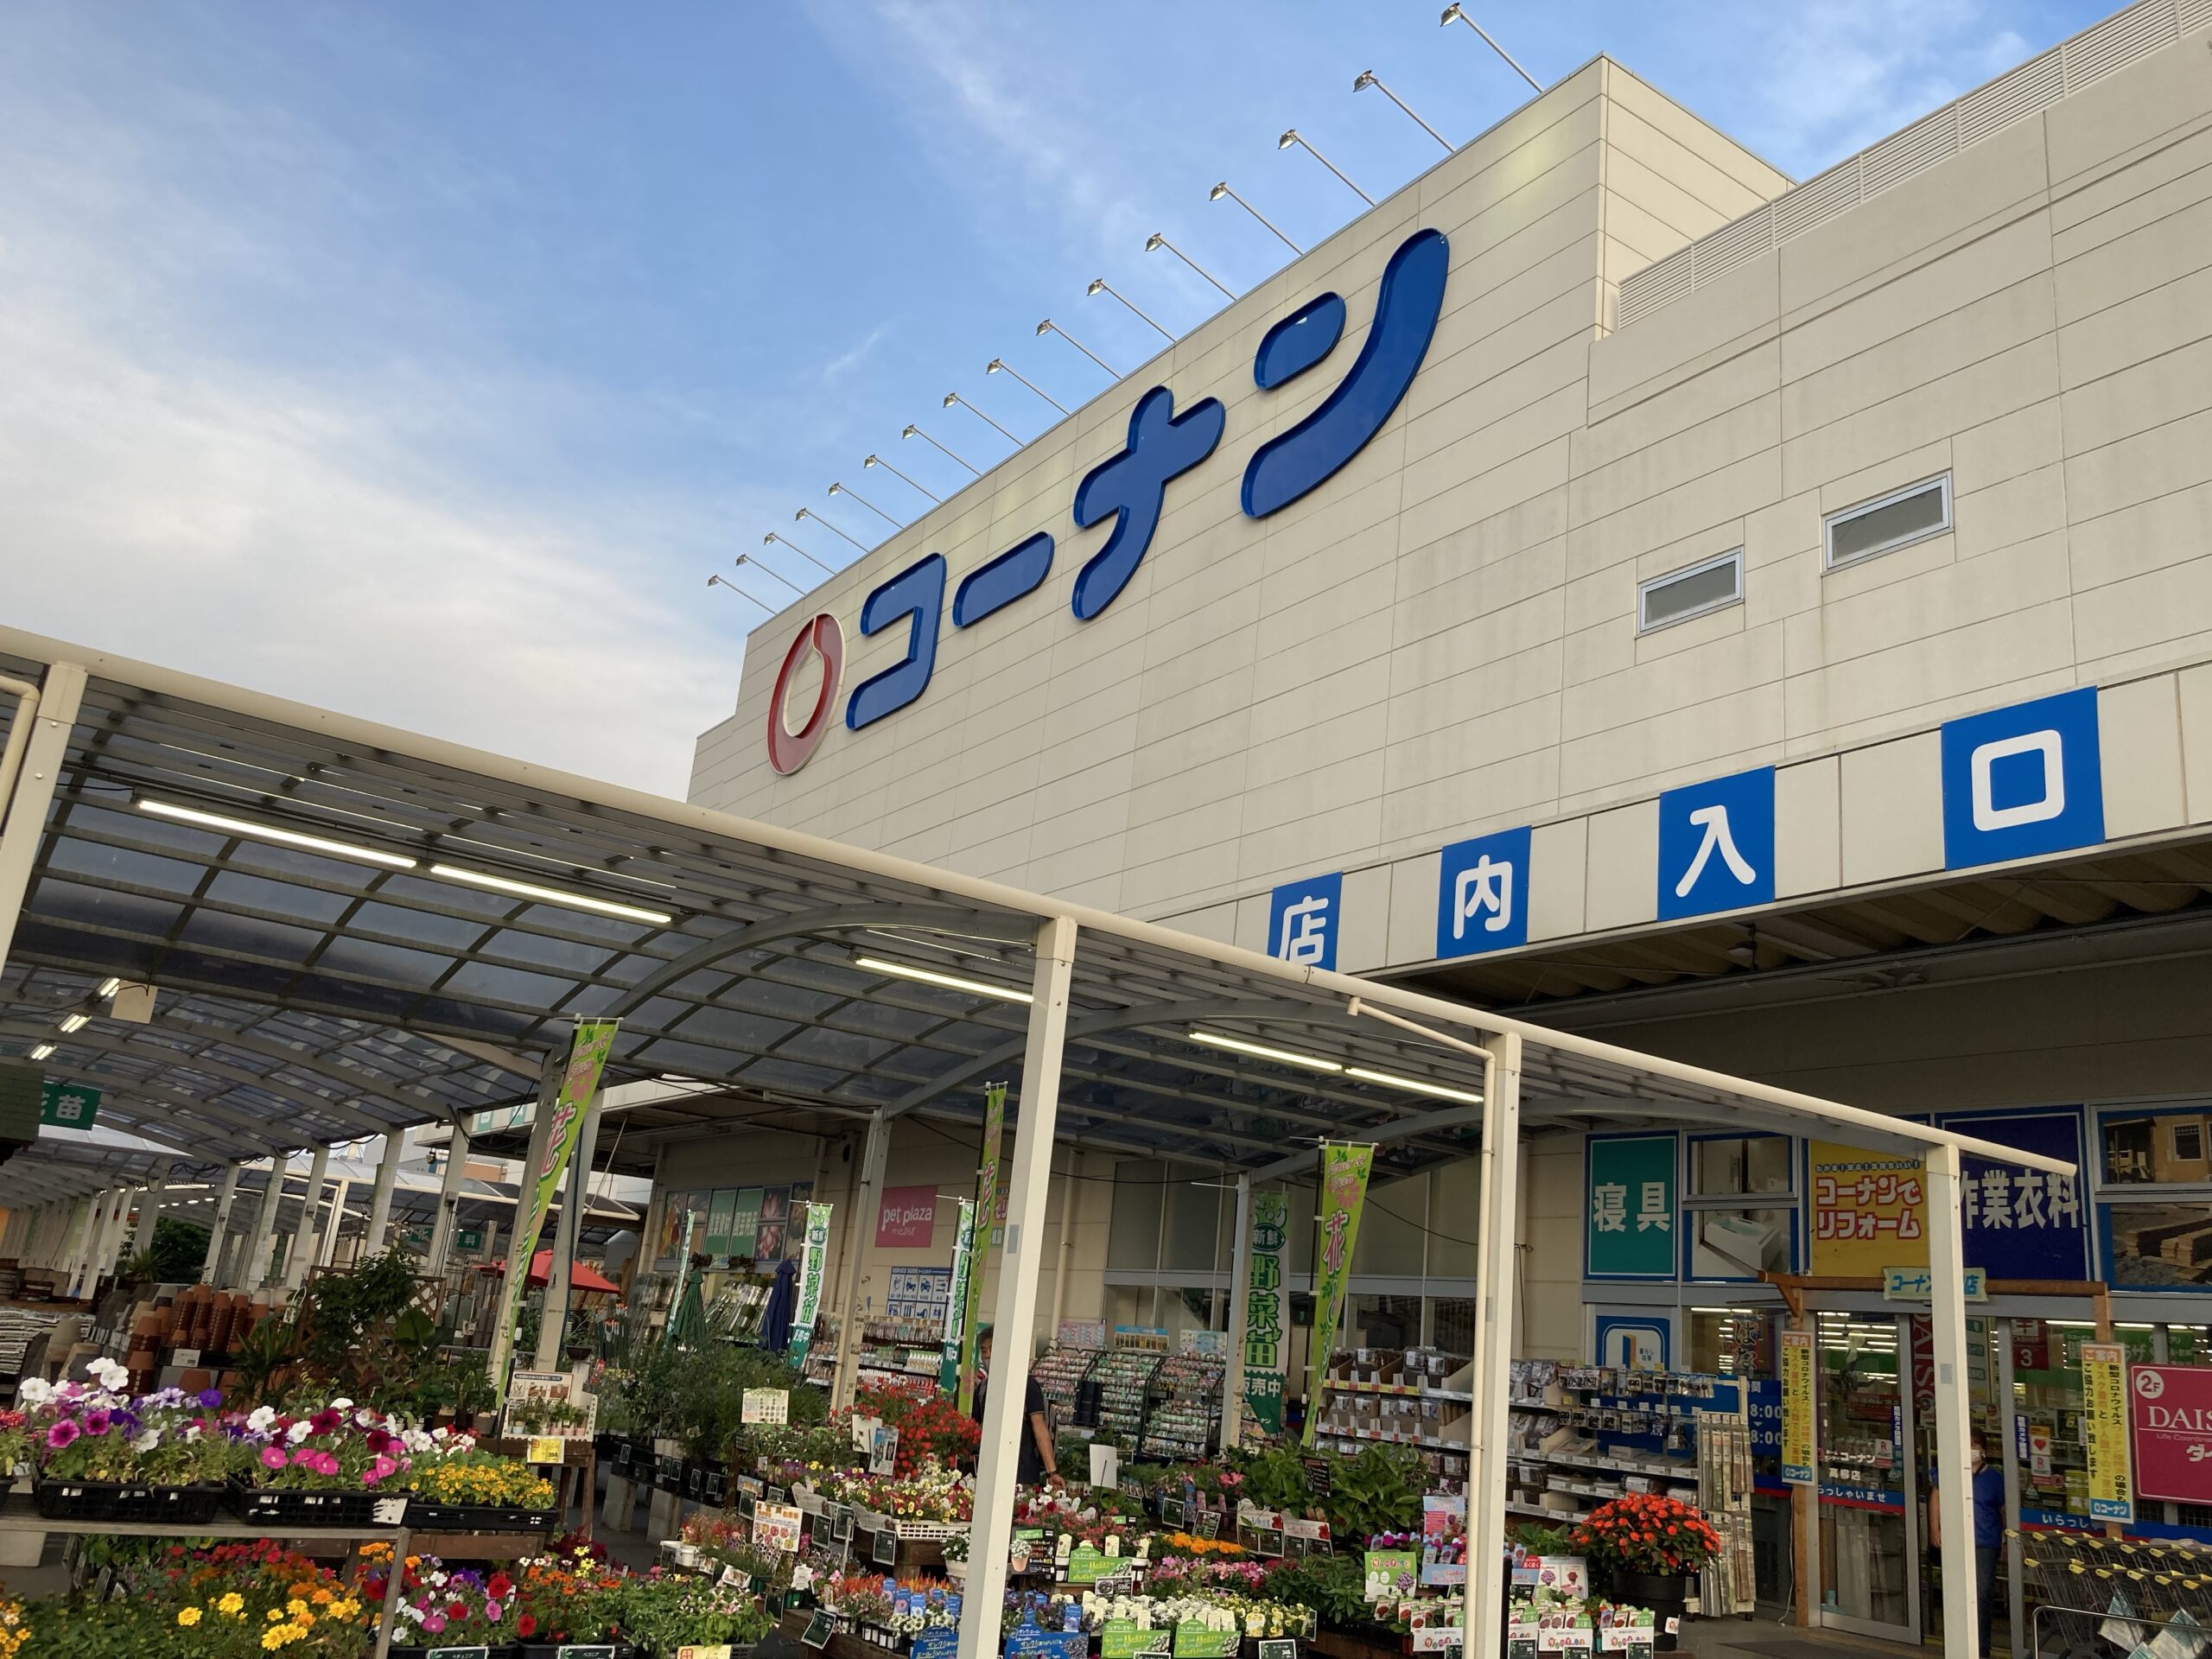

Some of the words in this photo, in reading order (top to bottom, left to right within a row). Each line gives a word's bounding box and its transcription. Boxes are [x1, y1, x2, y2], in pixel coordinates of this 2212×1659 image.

[845, 228, 1451, 731] コーナン
[1815, 1173, 1923, 1206] コーナンで
[1960, 1168, 2080, 1230] 作業衣料
[1593, 1181, 1672, 1234] 寝具
[881, 1207, 900, 1231] pet
[902, 1206, 932, 1226] plaza
[1816, 1209, 1923, 1240] リフォーム
[1252, 1227, 1280, 1246] 新鮮
[1324, 1210, 1350, 1276] 花
[800, 1246, 823, 1325] 野菜苗
[1245, 1252, 1282, 1370] 野菜苗
[1783, 1335, 1810, 1347] ご案内
[2020, 1348, 2033, 1367] 3
[2084, 1348, 2119, 1363] ご案内
[2140, 1374, 2161, 1393] 2F
[1750, 1403, 1782, 1419] 8:00
[2156, 1432, 2171, 1440] Life
[1840, 1451, 1877, 1464] コーナン
[2101, 1503, 2127, 1516] コーナン
[2041, 1514, 2091, 1529] いらっし
